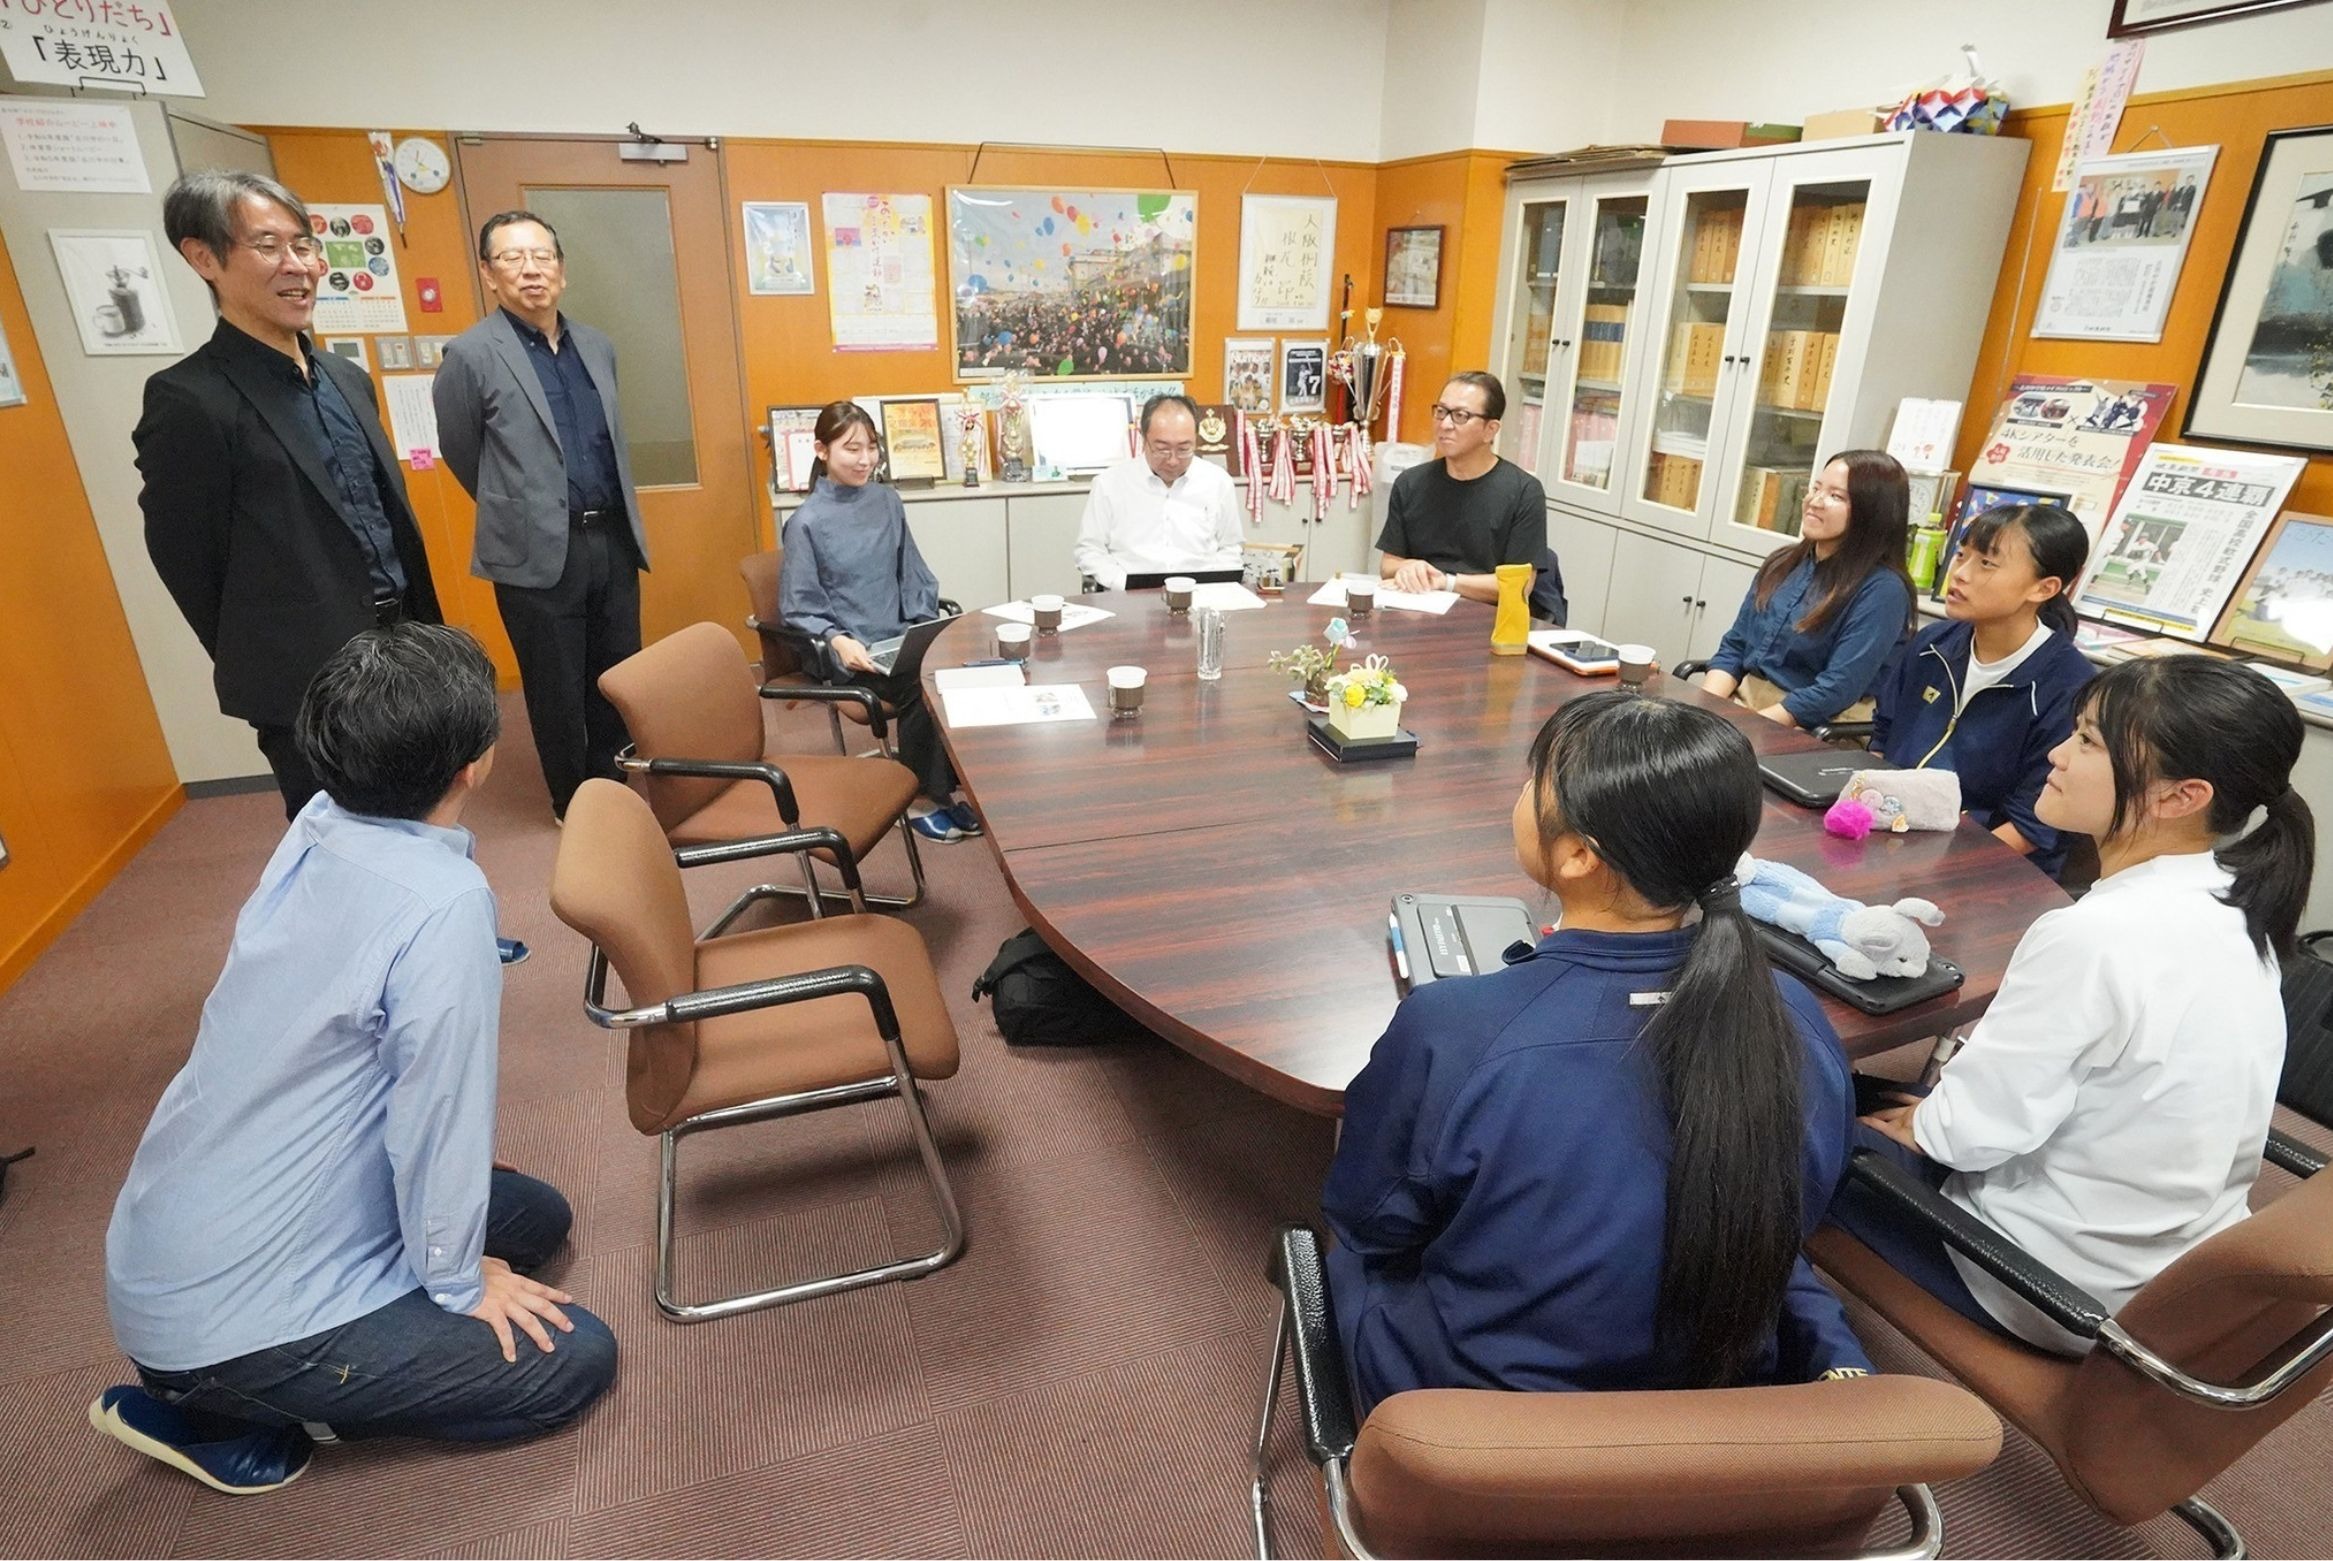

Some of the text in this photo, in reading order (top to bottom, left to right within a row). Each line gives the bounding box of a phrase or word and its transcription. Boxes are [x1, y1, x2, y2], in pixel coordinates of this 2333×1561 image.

[32, 36, 168, 81] 「表現力」
[1308, 375, 1321, 395] 7
[2001, 428, 2079, 448] 4Kシアターを
[2147, 473, 2271, 507] 中京4連覇
